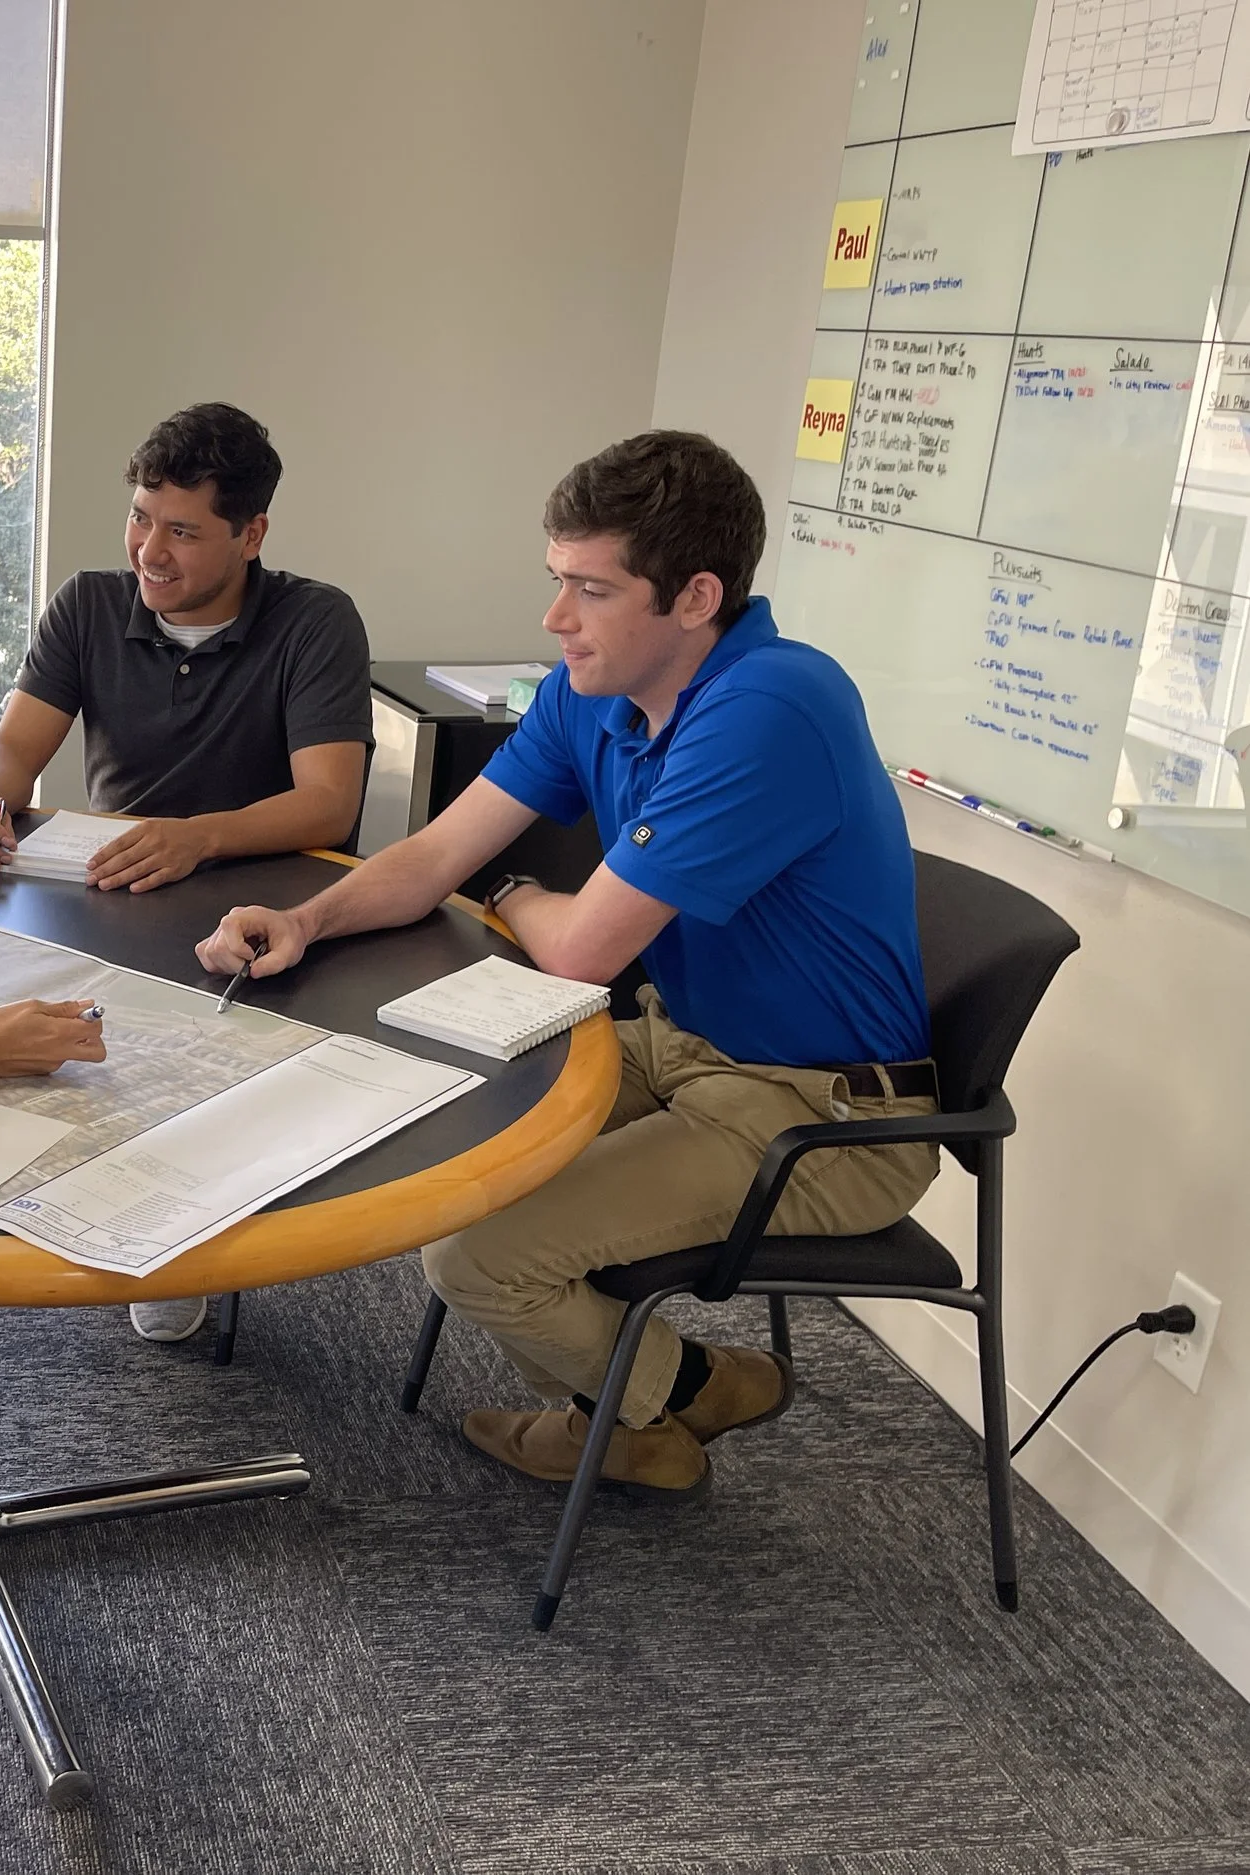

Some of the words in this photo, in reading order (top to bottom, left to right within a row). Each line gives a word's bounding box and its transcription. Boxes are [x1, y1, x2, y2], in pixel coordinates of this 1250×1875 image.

[834, 226, 871, 261] Paul
[884, 279, 906, 296] Hunts
[933, 276, 963, 290] station
[1018, 341, 1043, 359] Hunts
[1114, 347, 1150, 369] Salado
[1063, 386, 1073, 400] Up
[1144, 381, 1171, 391] review
[802, 403, 845, 437] Reyna
[993, 551, 1043, 583] Pursuits
[1017, 613, 1048, 637] Sycamore
